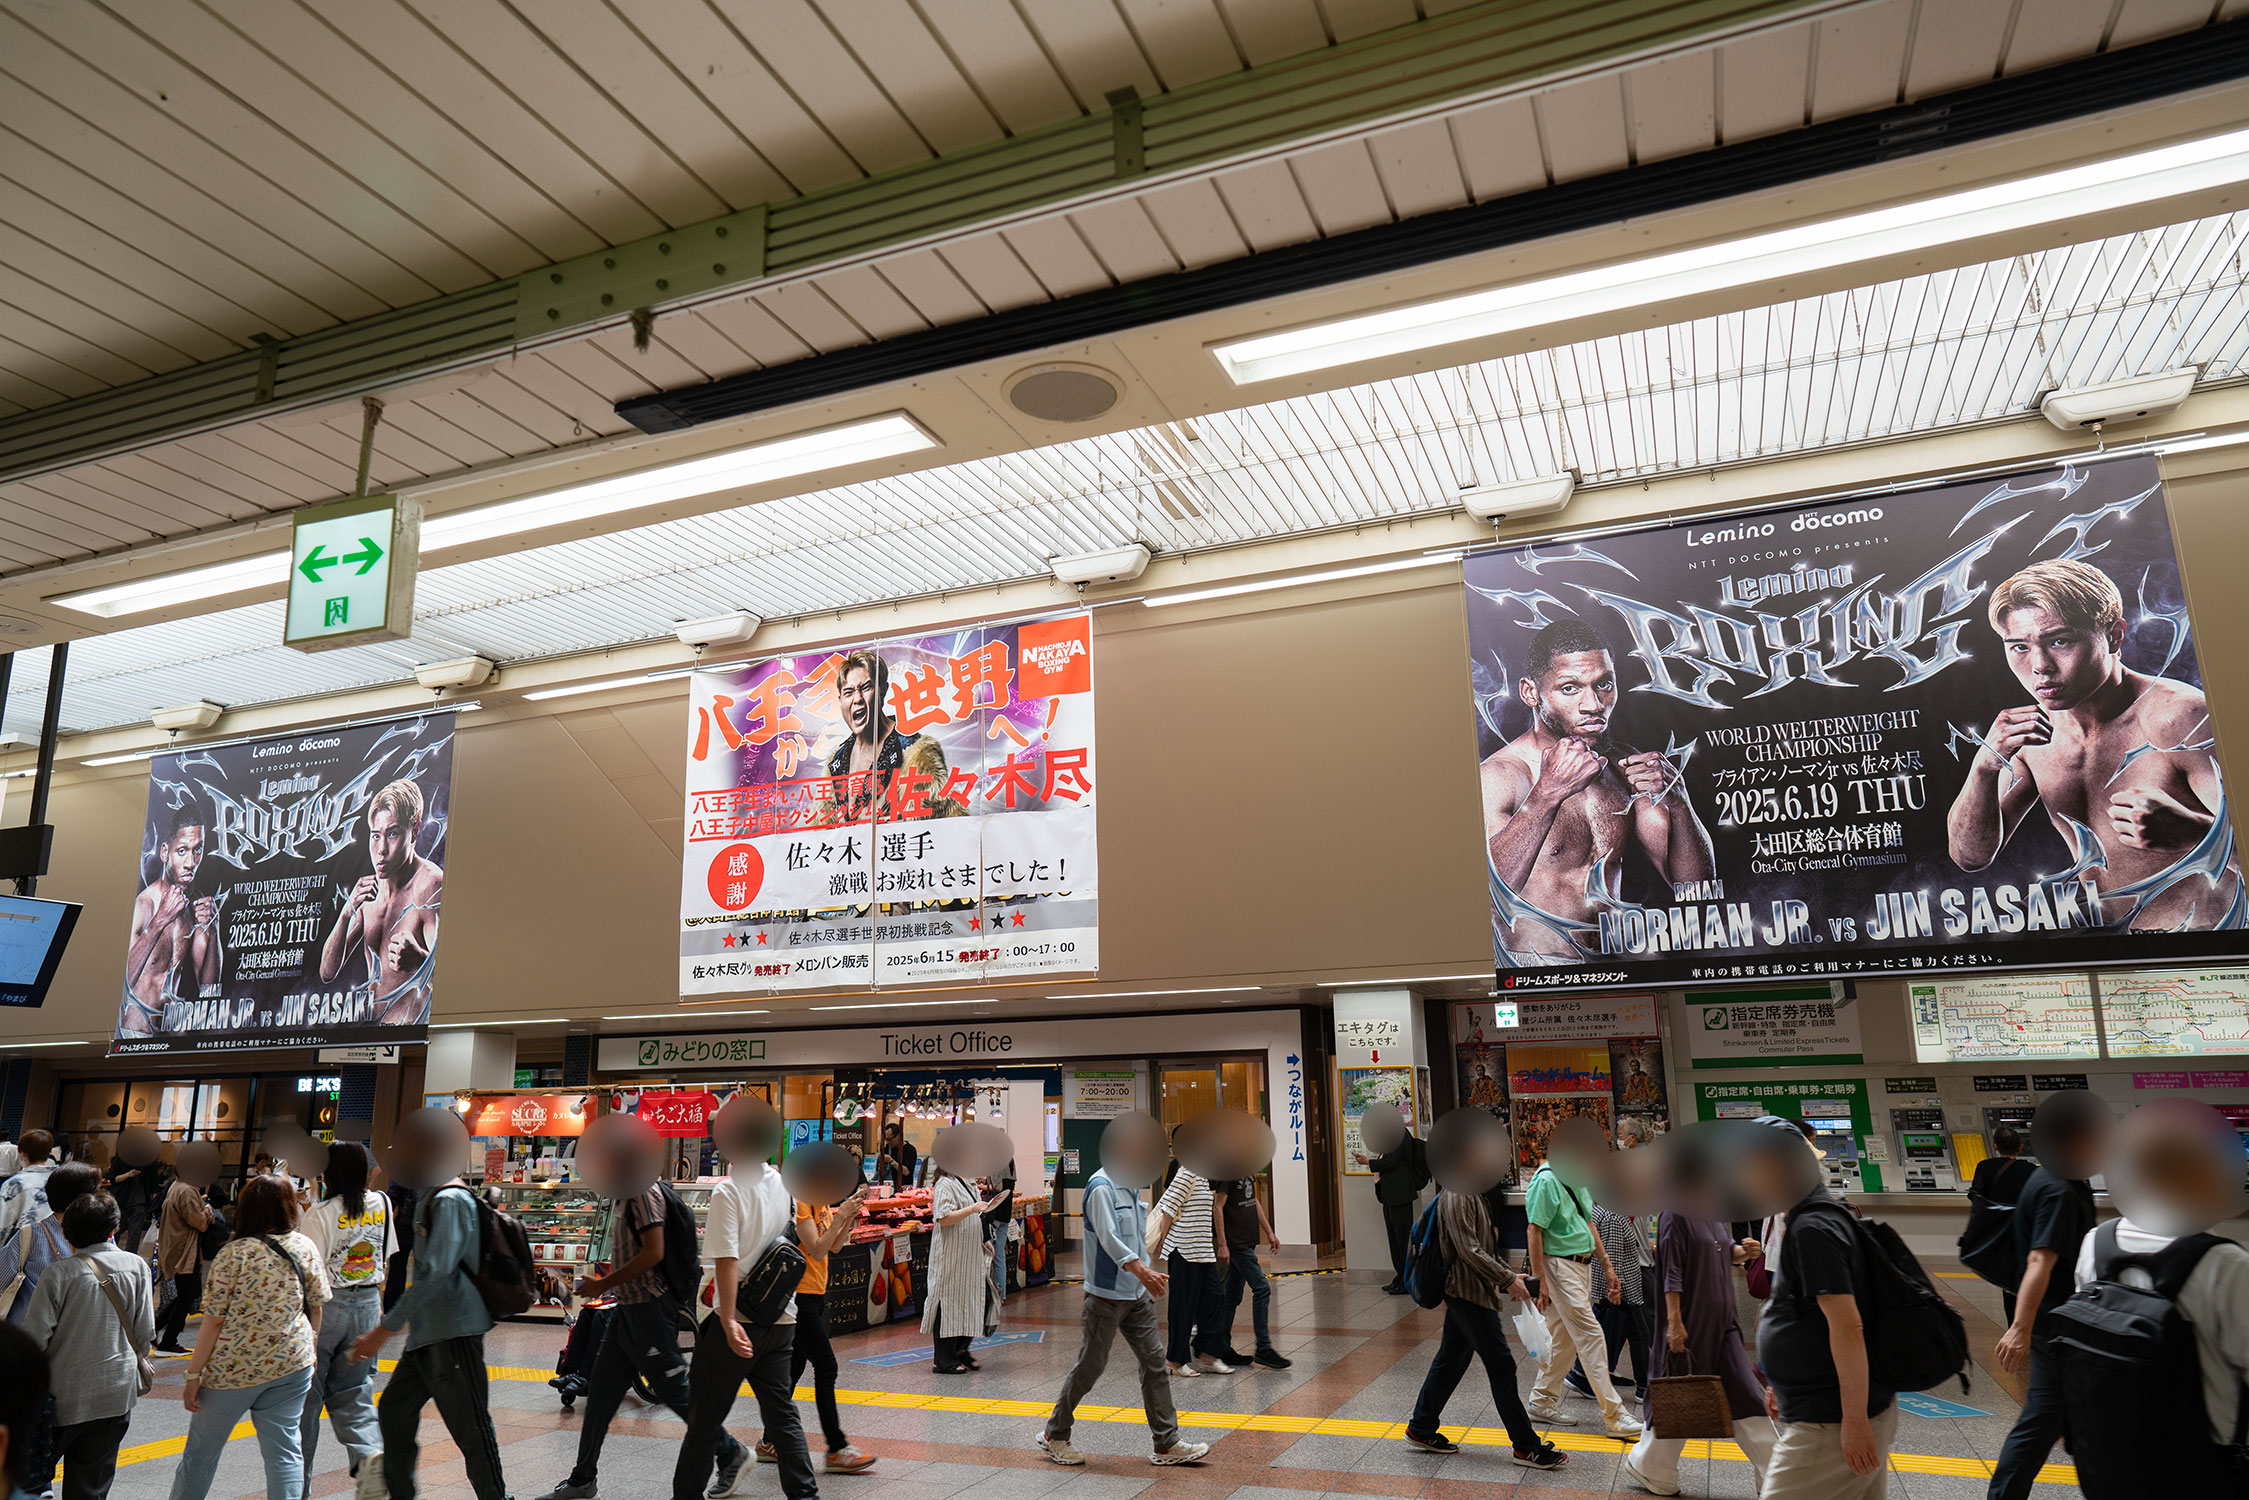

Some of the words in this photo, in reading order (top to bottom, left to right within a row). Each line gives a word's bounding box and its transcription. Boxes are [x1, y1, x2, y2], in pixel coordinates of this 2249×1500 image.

[1686, 522, 1775, 547] Lemino
[1790, 507, 1884, 532] docomo
[1688, 558, 1717, 571] NTT
[1729, 547, 1802, 565] DOCOMO
[1814, 536, 1889, 554] presents
[1716, 562, 1854, 608] Lemino
[1562, 511, 2034, 708] BOXING
[1022, 639, 1087, 664] NAKAYA
[1038, 641, 1072, 652] HACHIOJI
[1038, 656, 1070, 669] BOXING
[1044, 665, 1063, 675] GYM
[1705, 725, 1770, 748] WORLD
[1772, 709, 1920, 742] WELTERWEIGHT
[252, 743, 293, 759] Lemino
[299, 737, 341, 752] docomo
[1745, 732, 1883, 763] CHAMPIONSHIP
[268, 761, 301, 772] DOCOMO
[305, 757, 340, 768] presents
[1861, 750, 1924, 775] 佐々木尽
[259, 772, 321, 802] Lemino
[888, 747, 1092, 820] 佐々木尽
[193, 754, 390, 870] BOXING
[1715, 782, 1839, 826] 2025.6.19
[1847, 774, 1927, 815] THU
[785, 836, 863, 872] 佐々木
[880, 830, 935, 862] 選手
[1750, 821, 1904, 858] 大田区総合体育館
[1751, 858, 1797, 875] Ota-City
[1799, 855, 1841, 871] General
[1842, 851, 1908, 870] Gymnasium
[234, 880, 262, 895] WORLD
[263, 875, 327, 892] WELTERWEIGHT
[248, 889, 309, 906] CHAMPIONSHIP
[1673, 879, 1724, 902] BRIAN
[1600, 902, 1759, 956] NORMAN
[1761, 898, 1823, 946] JR.
[1865, 889, 1934, 941] JIN
[1942, 880, 2104, 937] SASAKI
[227, 921, 283, 948] 2025.6.19
[286, 918, 321, 943] THU
[161, 998, 230, 1032] NORMAN
[275, 994, 305, 1027] JIN
[307, 990, 375, 1026] SASAKI
[1731, 1003, 1835, 1022] 指定席券売機
[662, 1039, 767, 1062] みどりの窓口
[880, 1033, 942, 1056] Ticket
[949, 1031, 1013, 1053] Office
[1349, 1036, 1397, 1047] こちらです。
[1722, 1039, 1763, 1048] Shinkansen
[1769, 1038, 1795, 1046] Limited
[1759, 1046, 1795, 1054] Commuter
[1797, 1045, 1815, 1053] Pass
[1517, 1065, 1605, 1082] つながルーム
[1287, 1070, 1305, 1161] つながルーム
[848, 1131, 862, 1140] Office
